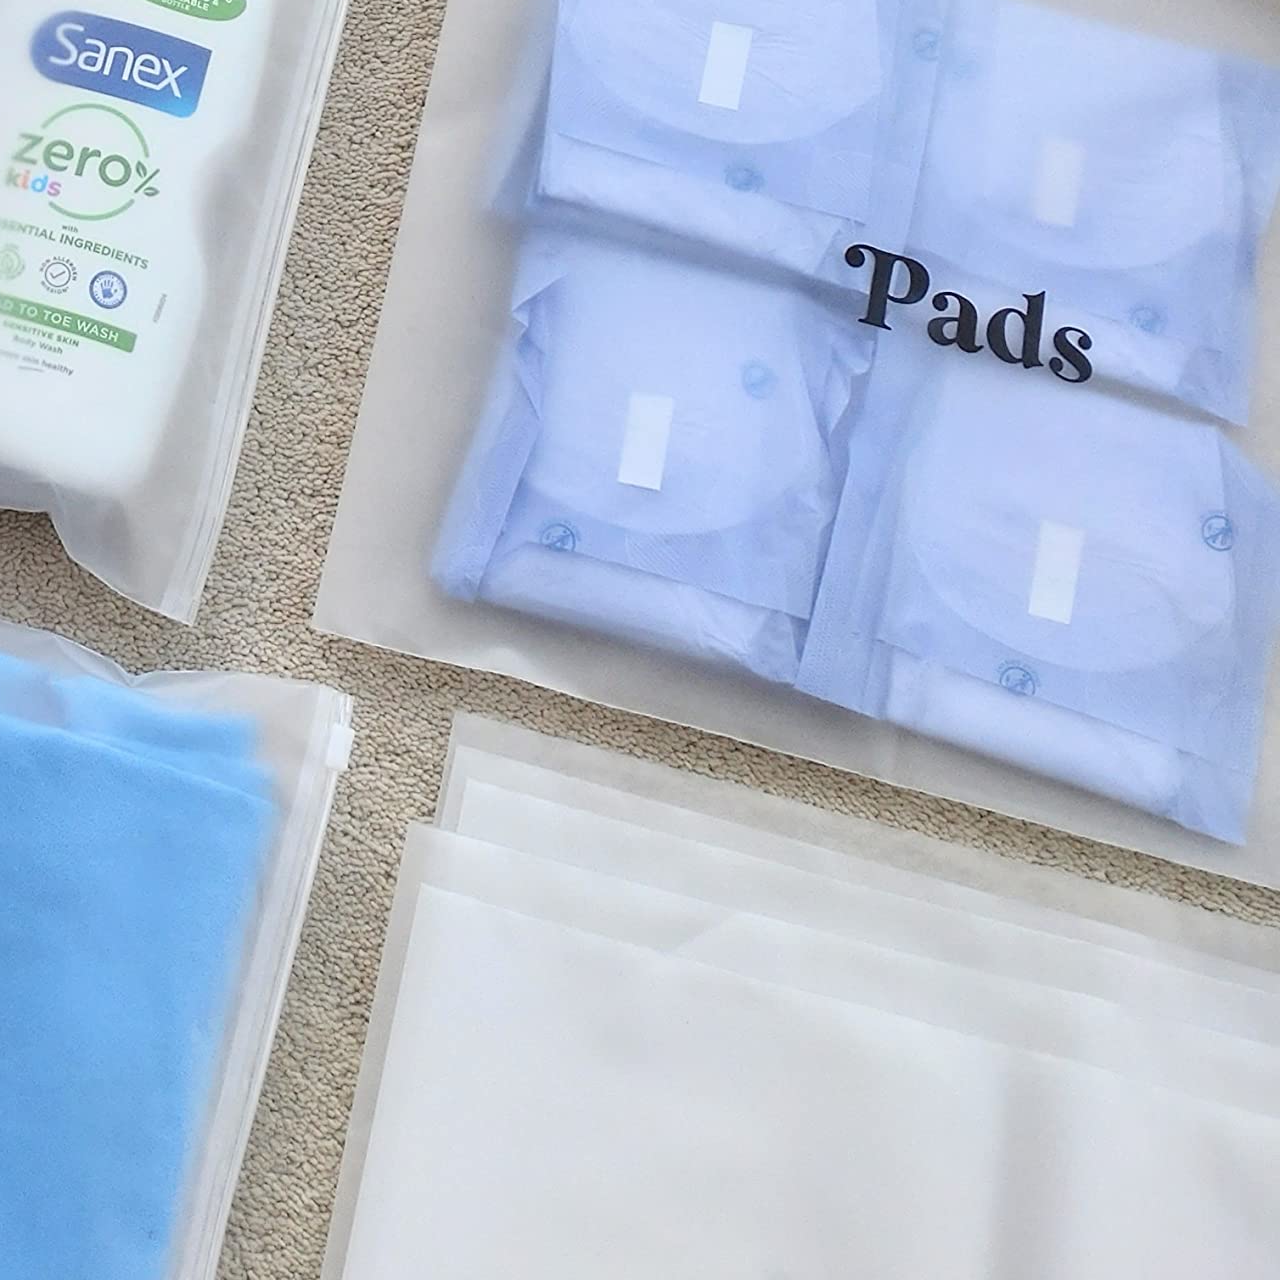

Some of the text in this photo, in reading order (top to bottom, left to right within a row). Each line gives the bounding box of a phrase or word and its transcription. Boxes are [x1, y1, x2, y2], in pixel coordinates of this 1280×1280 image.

[48, 22, 189, 99] Sanex
[5, 167, 62, 197] kids
[59, 233, 150, 270] INGREDIENTS
[19, 304, 39, 318] TO
[43, 310, 73, 327] TOE
[76, 319, 120, 342] WASH
[844, 244, 1093, 384] Pads
[56, 335, 80, 348] SKIN
